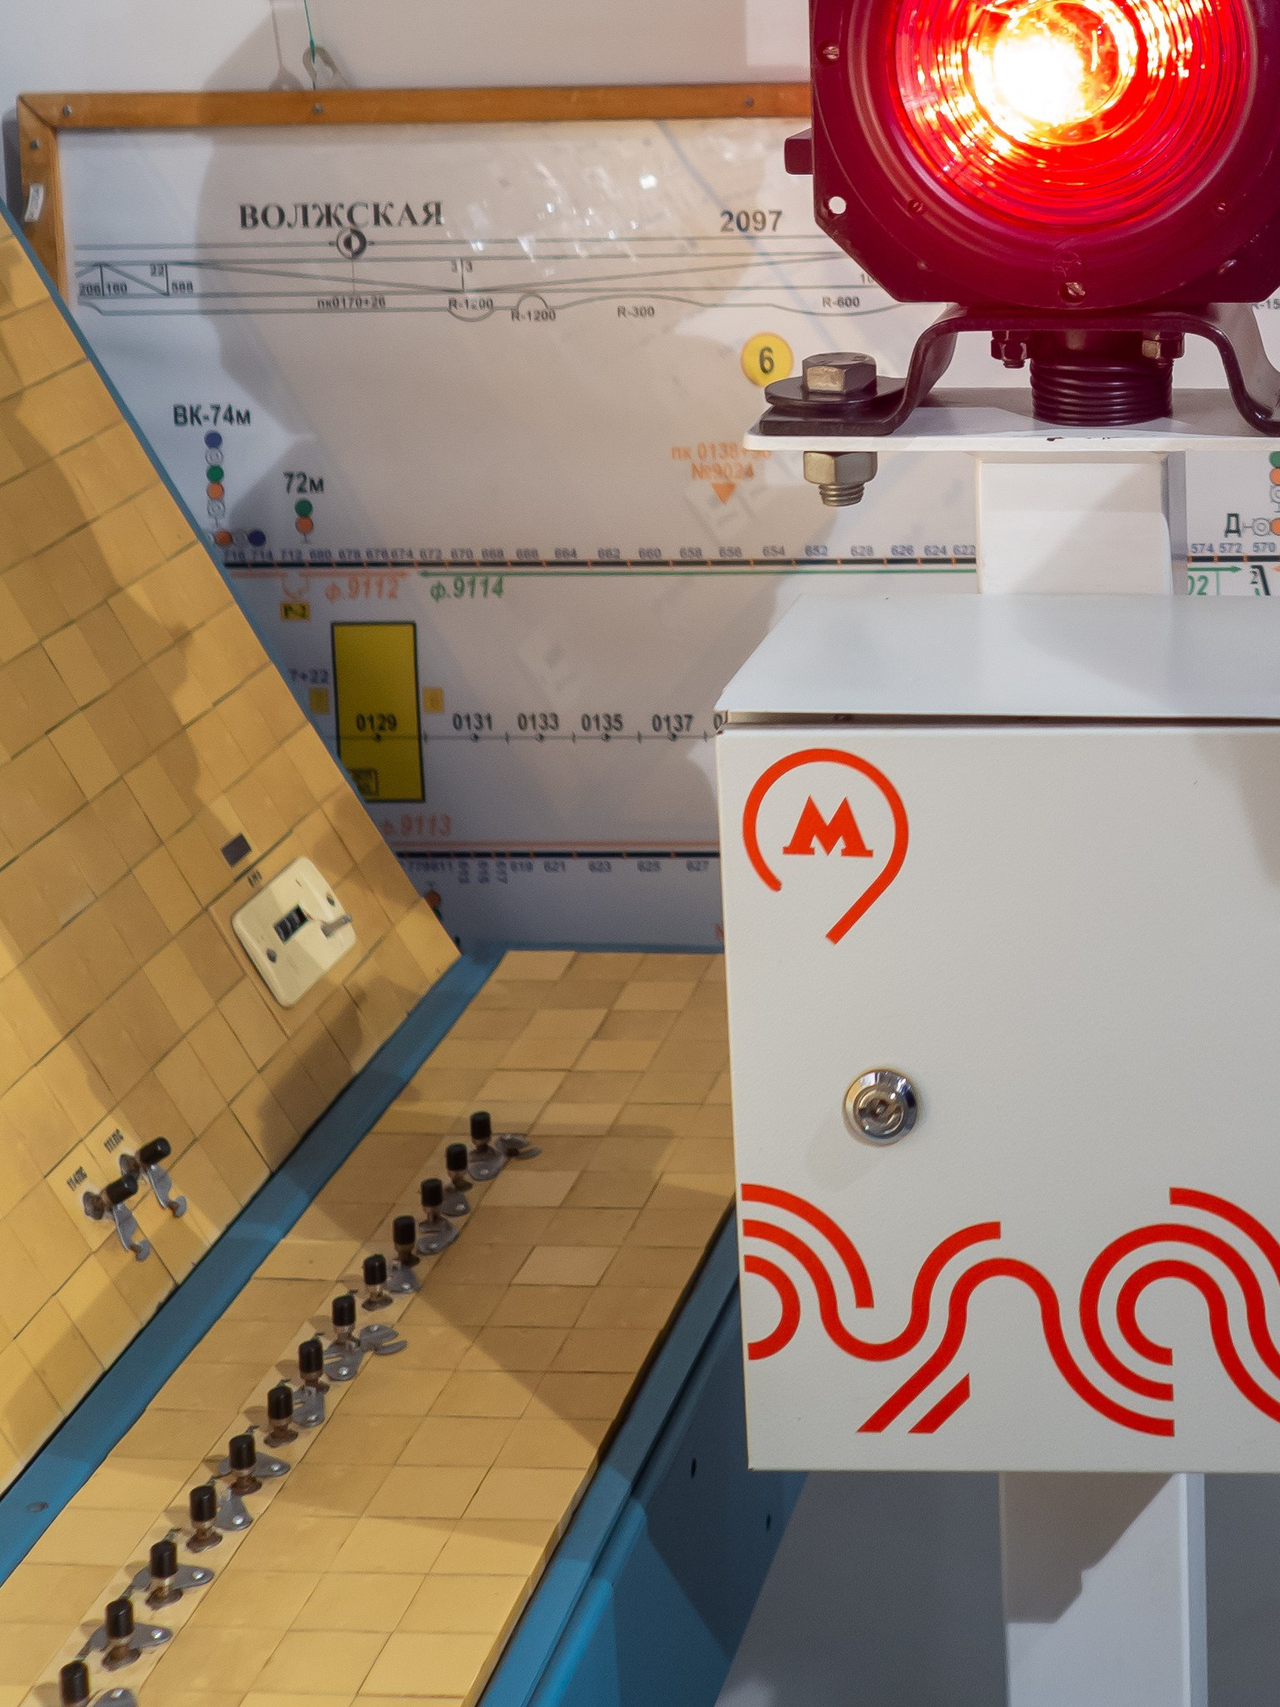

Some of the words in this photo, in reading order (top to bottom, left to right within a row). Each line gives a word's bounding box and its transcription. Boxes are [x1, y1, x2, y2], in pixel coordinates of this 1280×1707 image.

[239, 200, 443, 230] ВОЛЖСКАЯ
[720, 210, 783, 233] 2097
[617, 305, 656, 319] R-300
[758, 347, 774, 375] 6
[173, 404, 252, 426] ВК-74м
[283, 472, 325, 494] 72м
[1224, 513, 1242, 538] Д
[1190, 542, 1214, 553] 574
[1219, 542, 1242, 553] 572
[1252, 542, 1276, 553] 570
[429, 574, 504, 604] ф.9114
[355, 712, 398, 732] 0129
[451, 712, 493, 731] 0131
[517, 712, 560, 731] 0133
[580, 712, 623, 732] 0135
[651, 712, 694, 732] 0137
